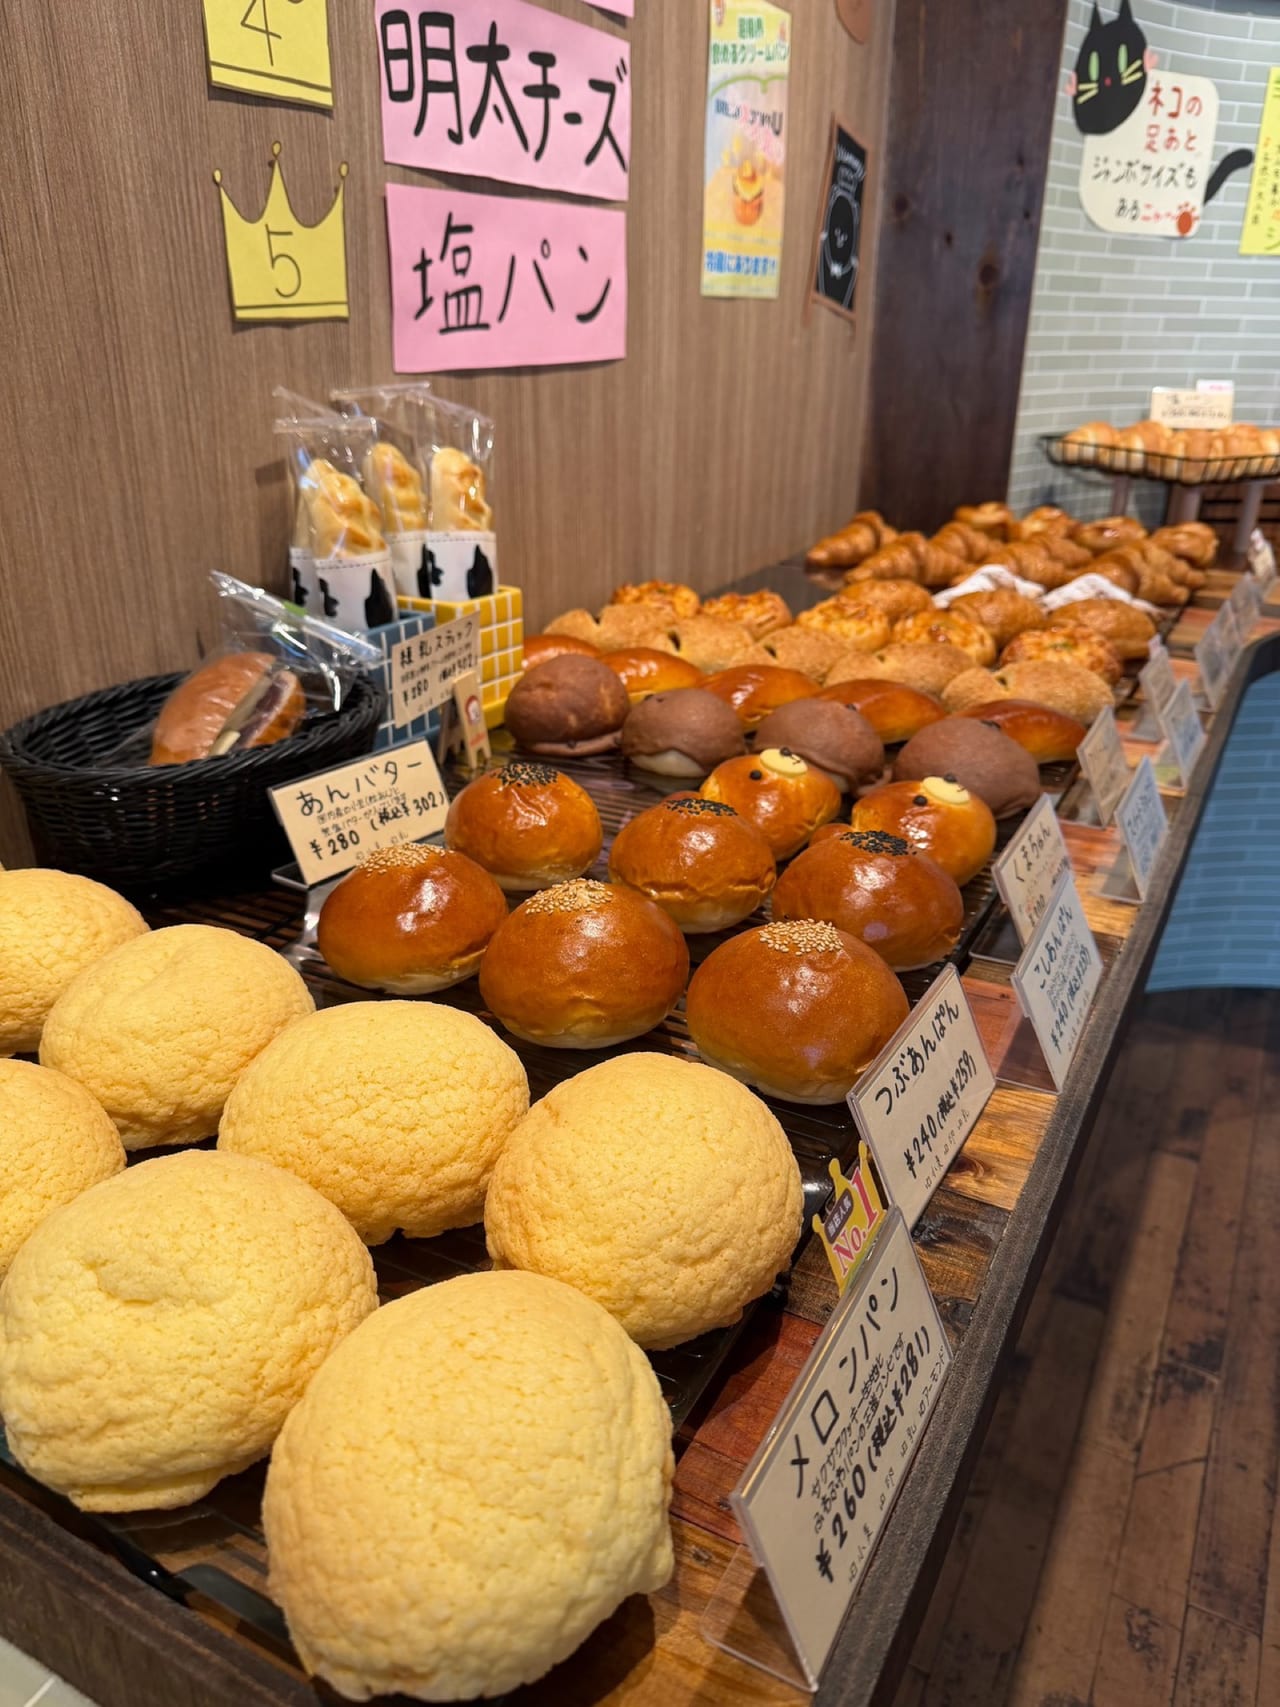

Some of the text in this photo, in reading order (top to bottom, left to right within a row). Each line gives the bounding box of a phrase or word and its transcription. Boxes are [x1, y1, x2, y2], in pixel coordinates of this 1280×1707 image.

[380, 9, 628, 173] 明太チーズ
[1148, 80, 1203, 119] ネコの
[1092, 156, 1198, 189] ジャンボサイズも
[1145, 123, 1197, 153] 足あと
[264, 223, 302, 298] 5
[411, 211, 611, 335] 塩パン
[296, 761, 422, 817] あんバター
[309, 829, 361, 861] ¥280
[875, 1000, 960, 1116] つぶあんぱん
[832, 1165, 879, 1278] No.1
[791, 1266, 898, 1499] メロンパン
